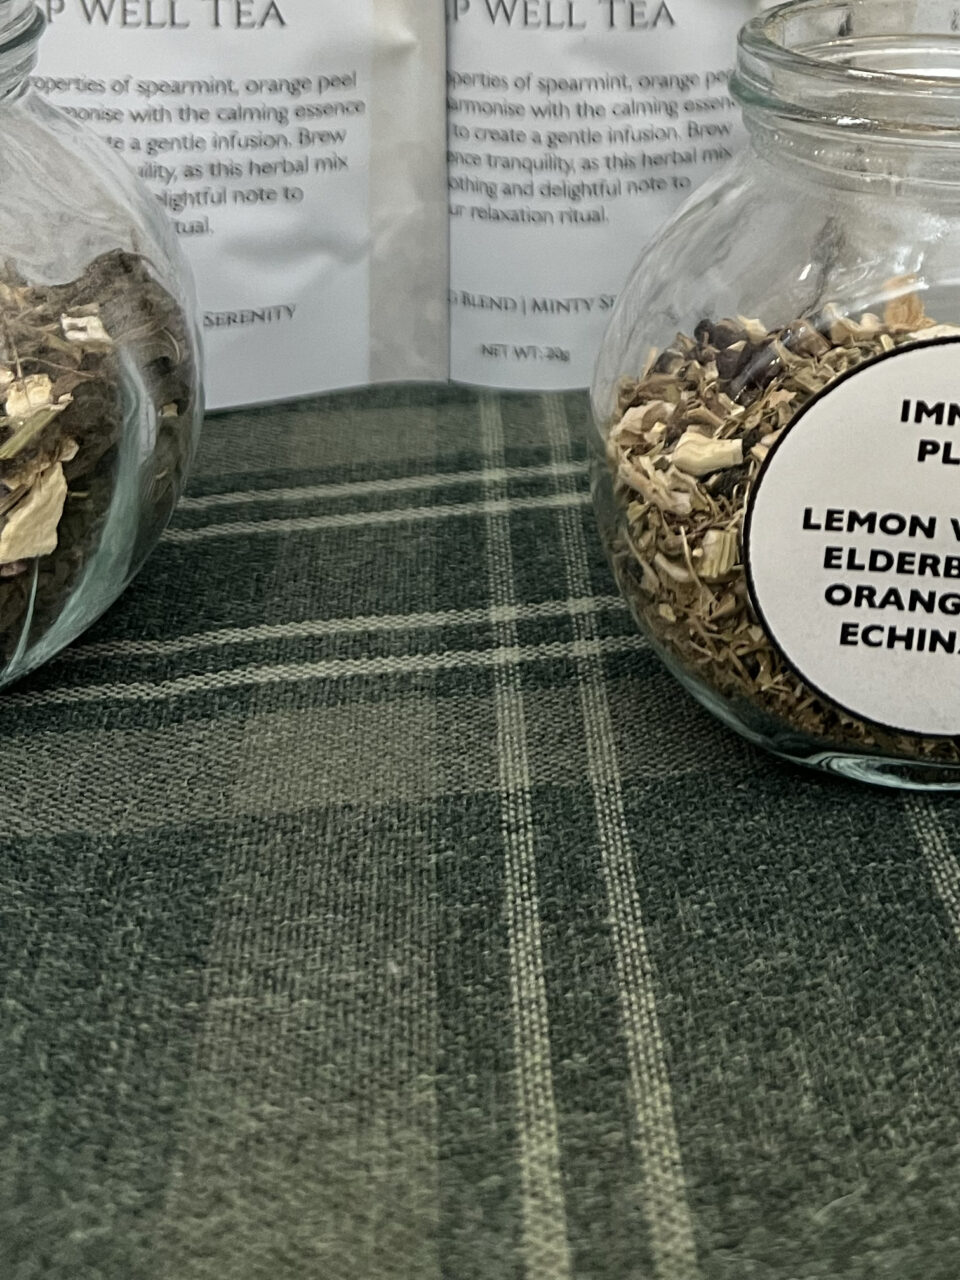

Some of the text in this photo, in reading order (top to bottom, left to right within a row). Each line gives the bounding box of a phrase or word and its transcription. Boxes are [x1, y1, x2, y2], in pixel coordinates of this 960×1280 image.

[111, 74, 132, 94] of
[136, 76, 239, 98] spearmint,
[244, 77, 312, 99] orange
[318, 69, 356, 95] peel
[514, 72, 533, 91] of
[536, 72, 633, 96] spearmint,
[638, 72, 700, 92] orange
[129, 103, 172, 122] with
[179, 103, 210, 122] the
[216, 102, 289, 127] calming
[295, 99, 366, 121] essence
[530, 100, 570, 119] with
[576, 100, 605, 118] the
[612, 97, 678, 119] calming
[147, 133, 206, 156] gentle
[212, 130, 292, 151] infusion.
[299, 126, 346, 147] Brew
[453, 120, 731, 149] to create a gentle infusion. Brew
[184, 164, 204, 180] as
[209, 158, 243, 178] this
[249, 155, 309, 175] herbal
[314, 152, 348, 172] mix
[581, 157, 600, 172] as
[604, 151, 637, 170] this
[641, 145, 698, 167] herbal
[702, 143, 733, 163] mix
[232, 188, 277, 205] note
[282, 186, 304, 203] to
[502, 179, 534, 198] and
[539, 178, 622, 202] delightful
[627, 176, 668, 197] note
[671, 175, 692, 191] to
[471, 202, 555, 225] relaxation
[559, 204, 609, 225] ritual.
[203, 302, 297, 328] SERENITY
[461, 290, 518, 311] BLEND
[532, 296, 595, 315] MINTY
[480, 342, 508, 359] NET
[802, 507, 937, 539] LEMON
